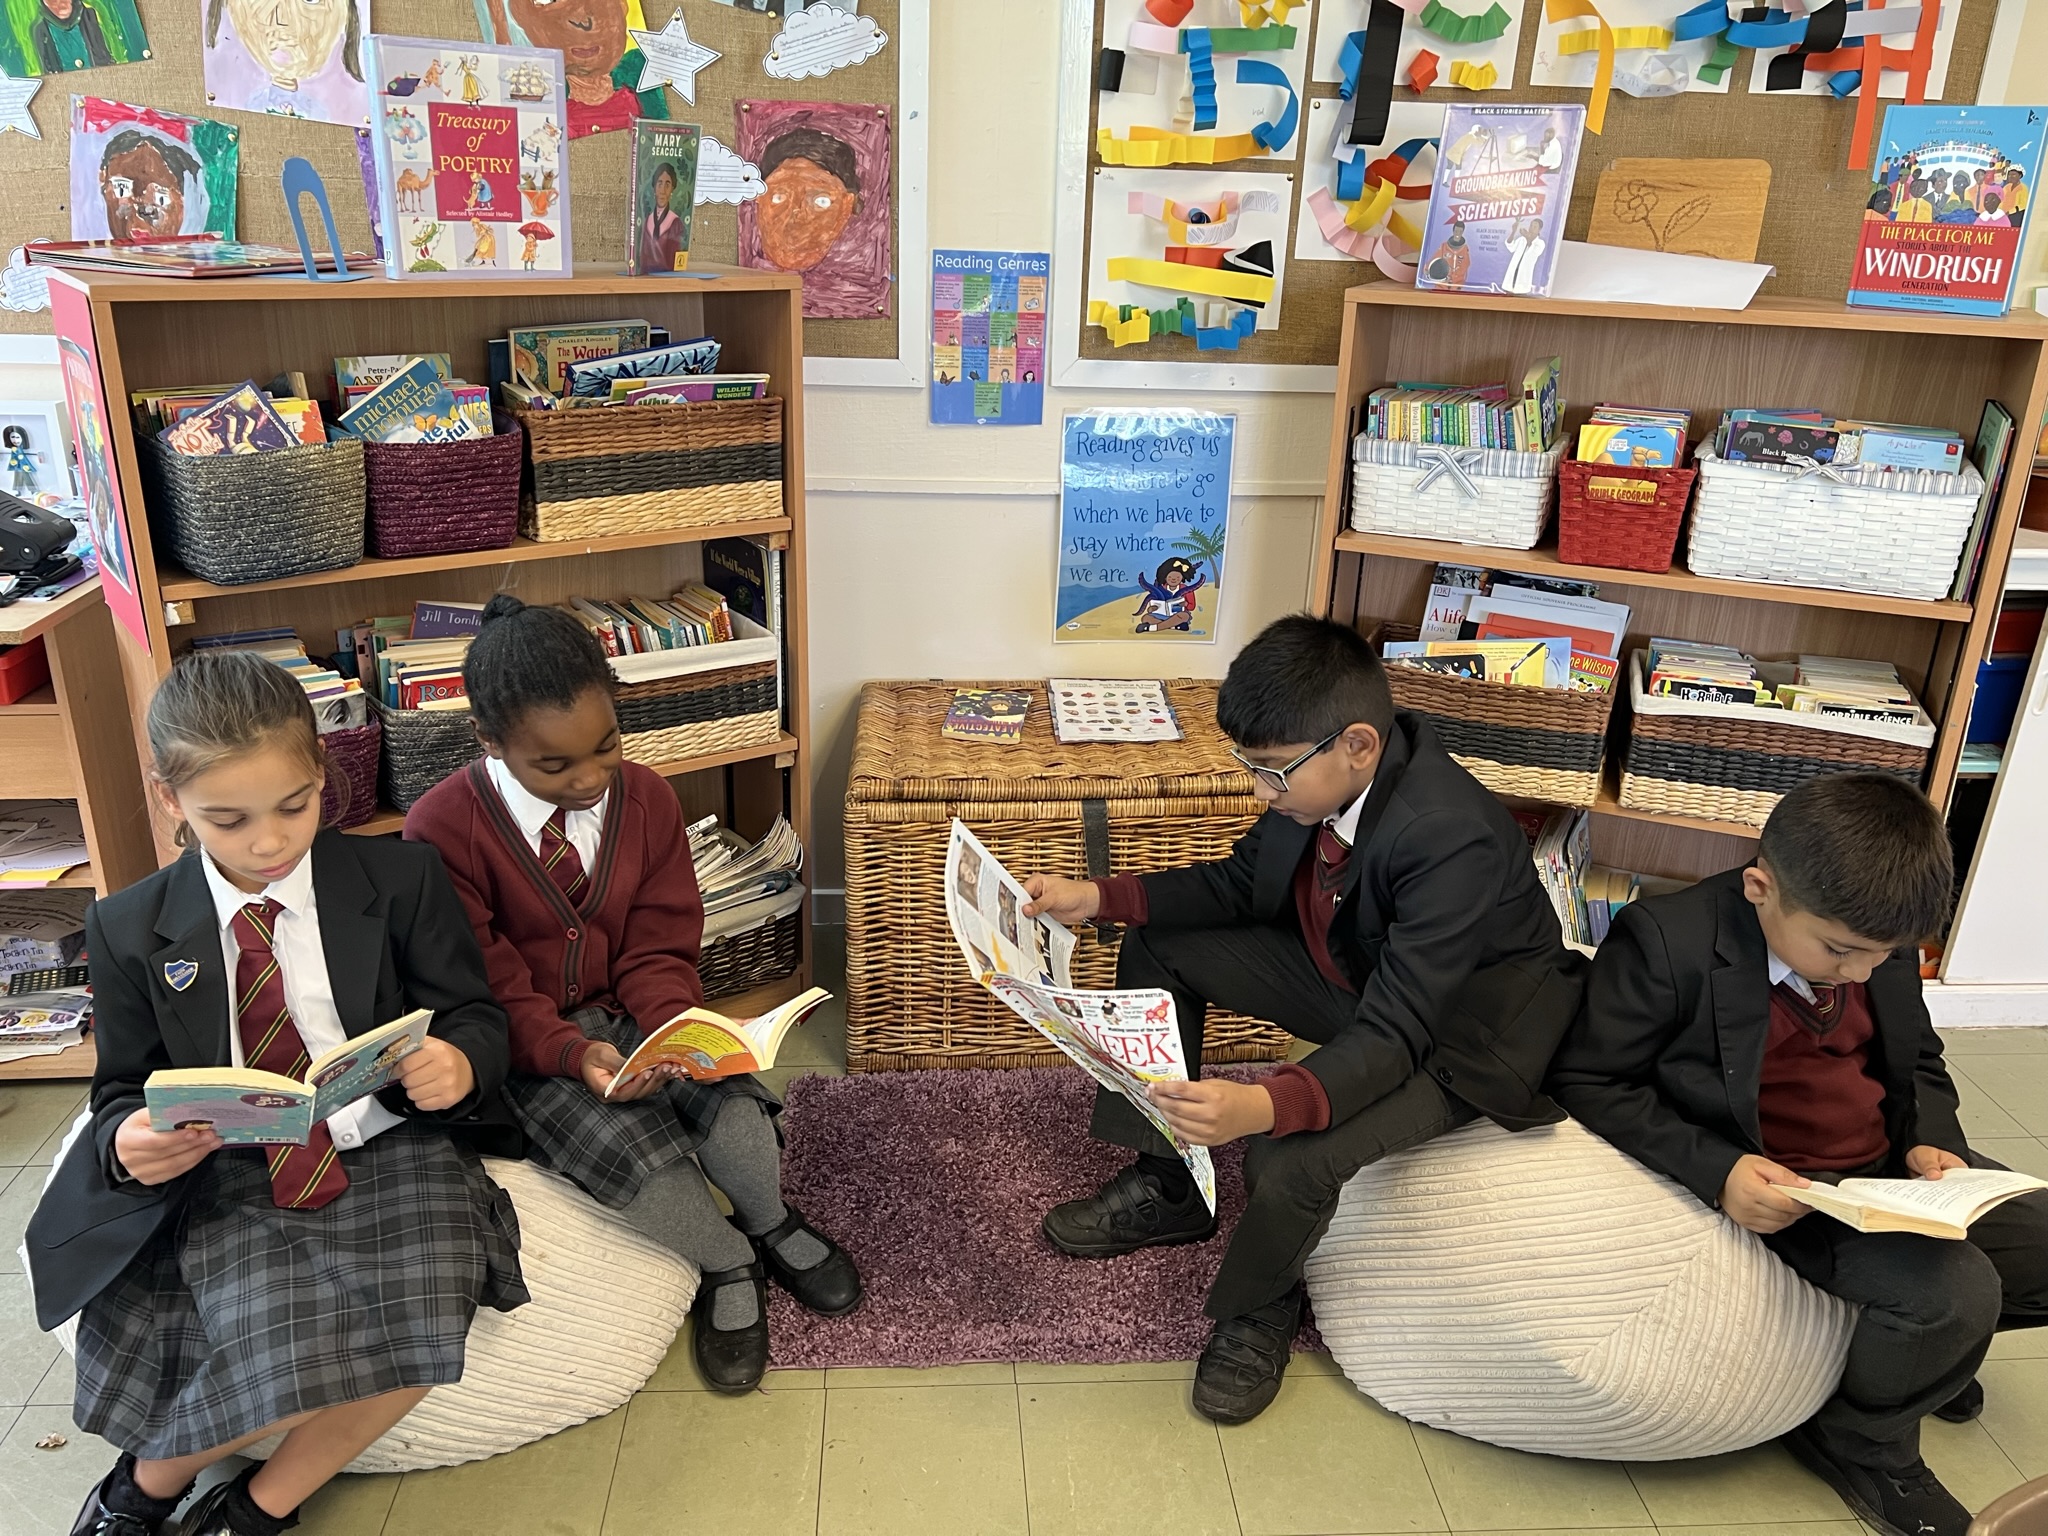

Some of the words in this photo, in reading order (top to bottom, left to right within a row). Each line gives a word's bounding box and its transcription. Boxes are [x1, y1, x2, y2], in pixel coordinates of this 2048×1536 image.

[437, 112, 511, 135] Treasury
[466, 132, 486, 153] of
[655, 133, 681, 148] MARY
[651, 147, 683, 157] SEACOLE
[439, 155, 514, 174] POETRY
[1454, 169, 1538, 195] GROUNDBREAKING
[1457, 197, 1537, 221] SCIENTISTS
[1880, 226, 1901, 240] THE
[1903, 227, 1942, 243] PLACE
[1945, 228, 1972, 246] FOR
[1974, 231, 1996, 246] ME
[1895, 241, 1927, 251] STORIES
[1929, 243, 1954, 253] ABOUT
[935, 254, 993, 273] Reading
[997, 256, 1047, 271] Genres
[1865, 247, 2003, 285] WINDRUSH
[1901, 280, 1949, 292] GENERATION
[557, 347, 570, 357] The
[572, 345, 614, 360] Water
[367, 367, 401, 376] Peter-Pa
[716, 386, 753, 394] WILDLIFE
[716, 391, 751, 399] WONDERS
[353, 374, 422, 432] michael
[364, 381, 440, 442] morpurgo
[1412, 406, 1420, 426] Roald
[1470, 405, 1478, 426] Roald
[176, 419, 211, 455] NOT
[1076, 431, 1147, 462] Reading
[1150, 436, 1195, 462] gives
[1202, 436, 1220, 457] us
[1761, 447, 1780, 456] Black
[1175, 468, 1188, 488] to
[1192, 473, 1215, 498] go
[1588, 487, 1615, 500] RRIBLE
[1616, 488, 1655, 503] GEOGRAPH
[1074, 499, 1119, 524] when
[1126, 506, 1149, 524] we
[1155, 499, 1192, 524] have
[1200, 503, 1215, 523] to
[1070, 535, 1108, 559] stay
[1115, 533, 1165, 552] where
[1070, 567, 1092, 583] we
[1098, 567, 1129, 583] are.
[1435, 588, 1449, 597] DK
[1542, 597, 1566, 605] SOUVENIR
[1566, 601, 1597, 610] PROGRAMME
[421, 610, 441, 622] Jill
[1429, 611, 1439, 622] A
[1443, 608, 1466, 625] life
[1426, 623, 1447, 633] How
[1581, 657, 1613, 676] Wilson
[1680, 687, 1734, 704] HORRIBLE
[1822, 709, 1871, 721] HORRIBLE
[1873, 711, 1912, 725] SCIENCE
